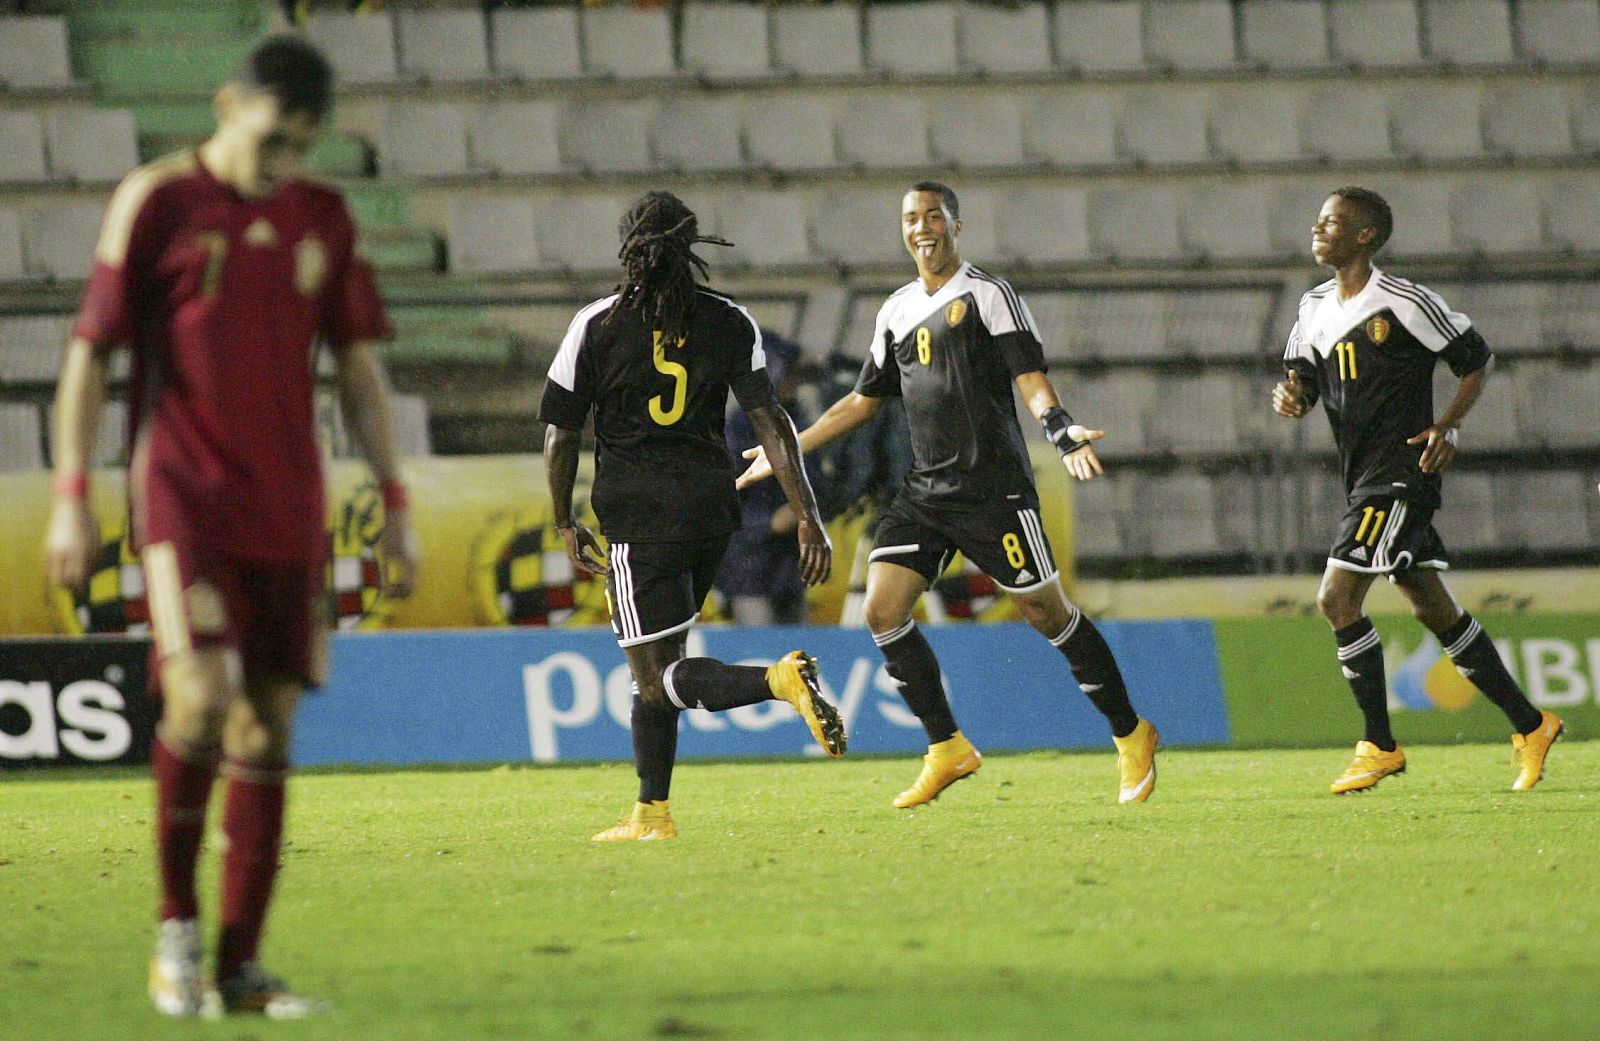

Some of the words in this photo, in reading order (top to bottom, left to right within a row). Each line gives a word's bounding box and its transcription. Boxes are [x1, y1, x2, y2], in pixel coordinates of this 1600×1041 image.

[916, 326, 931, 366] 8
[1335, 341, 1357, 381] 11
[648, 330, 688, 426] 5
[1354, 506, 1386, 547] 11
[1002, 532, 1025, 570] 8
